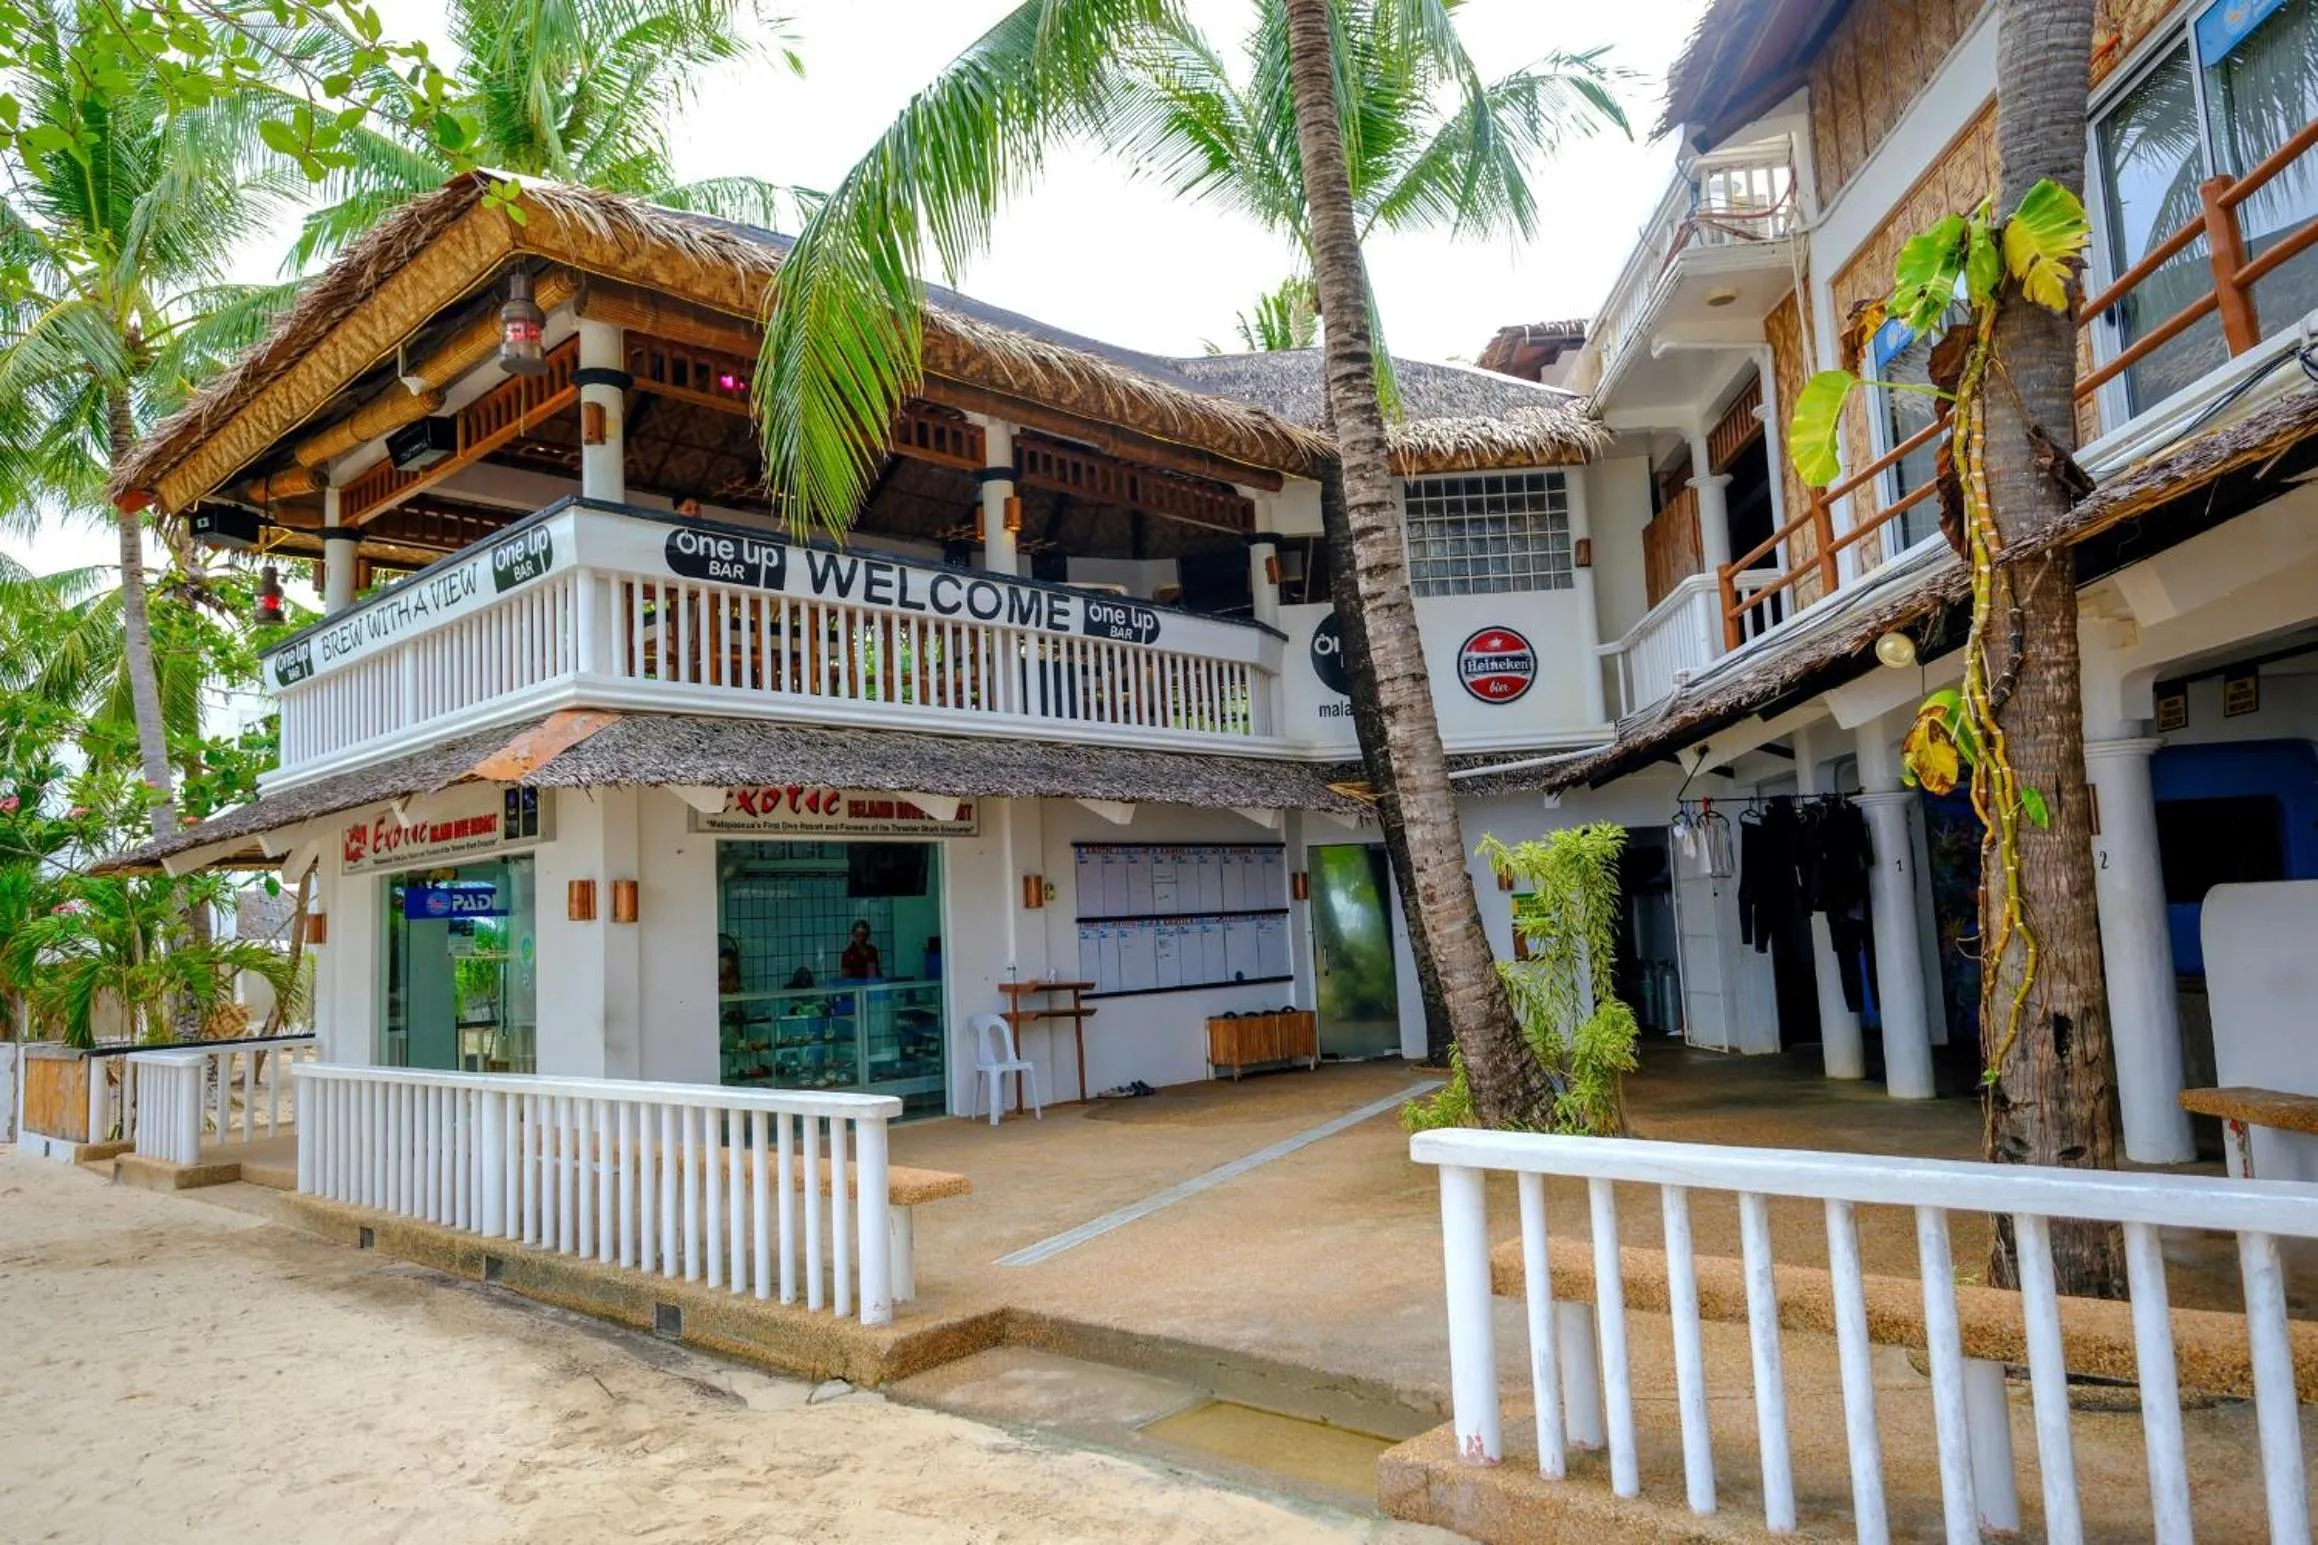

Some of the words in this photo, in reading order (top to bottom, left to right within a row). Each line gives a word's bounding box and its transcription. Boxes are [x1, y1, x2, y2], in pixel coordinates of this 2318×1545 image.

[495, 539, 525, 571] one
[527, 529, 548, 573] up
[676, 529, 735, 561] one
[742, 537, 779, 588] up
[514, 560, 535, 582] BAR
[708, 560, 746, 580] BAR
[805, 550, 1071, 631] WELCOME
[320, 618, 363, 662] BREW
[366, 595, 412, 640] WITH
[413, 590, 429, 619] A
[430, 561, 480, 611] VIEW
[1089, 600, 1126, 625] one
[1131, 607, 1155, 645] up
[1110, 625, 1134, 640] BAR
[1467, 657, 1530, 673] Heineken
[1489, 680, 1510, 693] bier
[1318, 700, 1354, 718] mala
[1895, 859, 1904, 872] 1
[2099, 851, 2109, 869] 2
